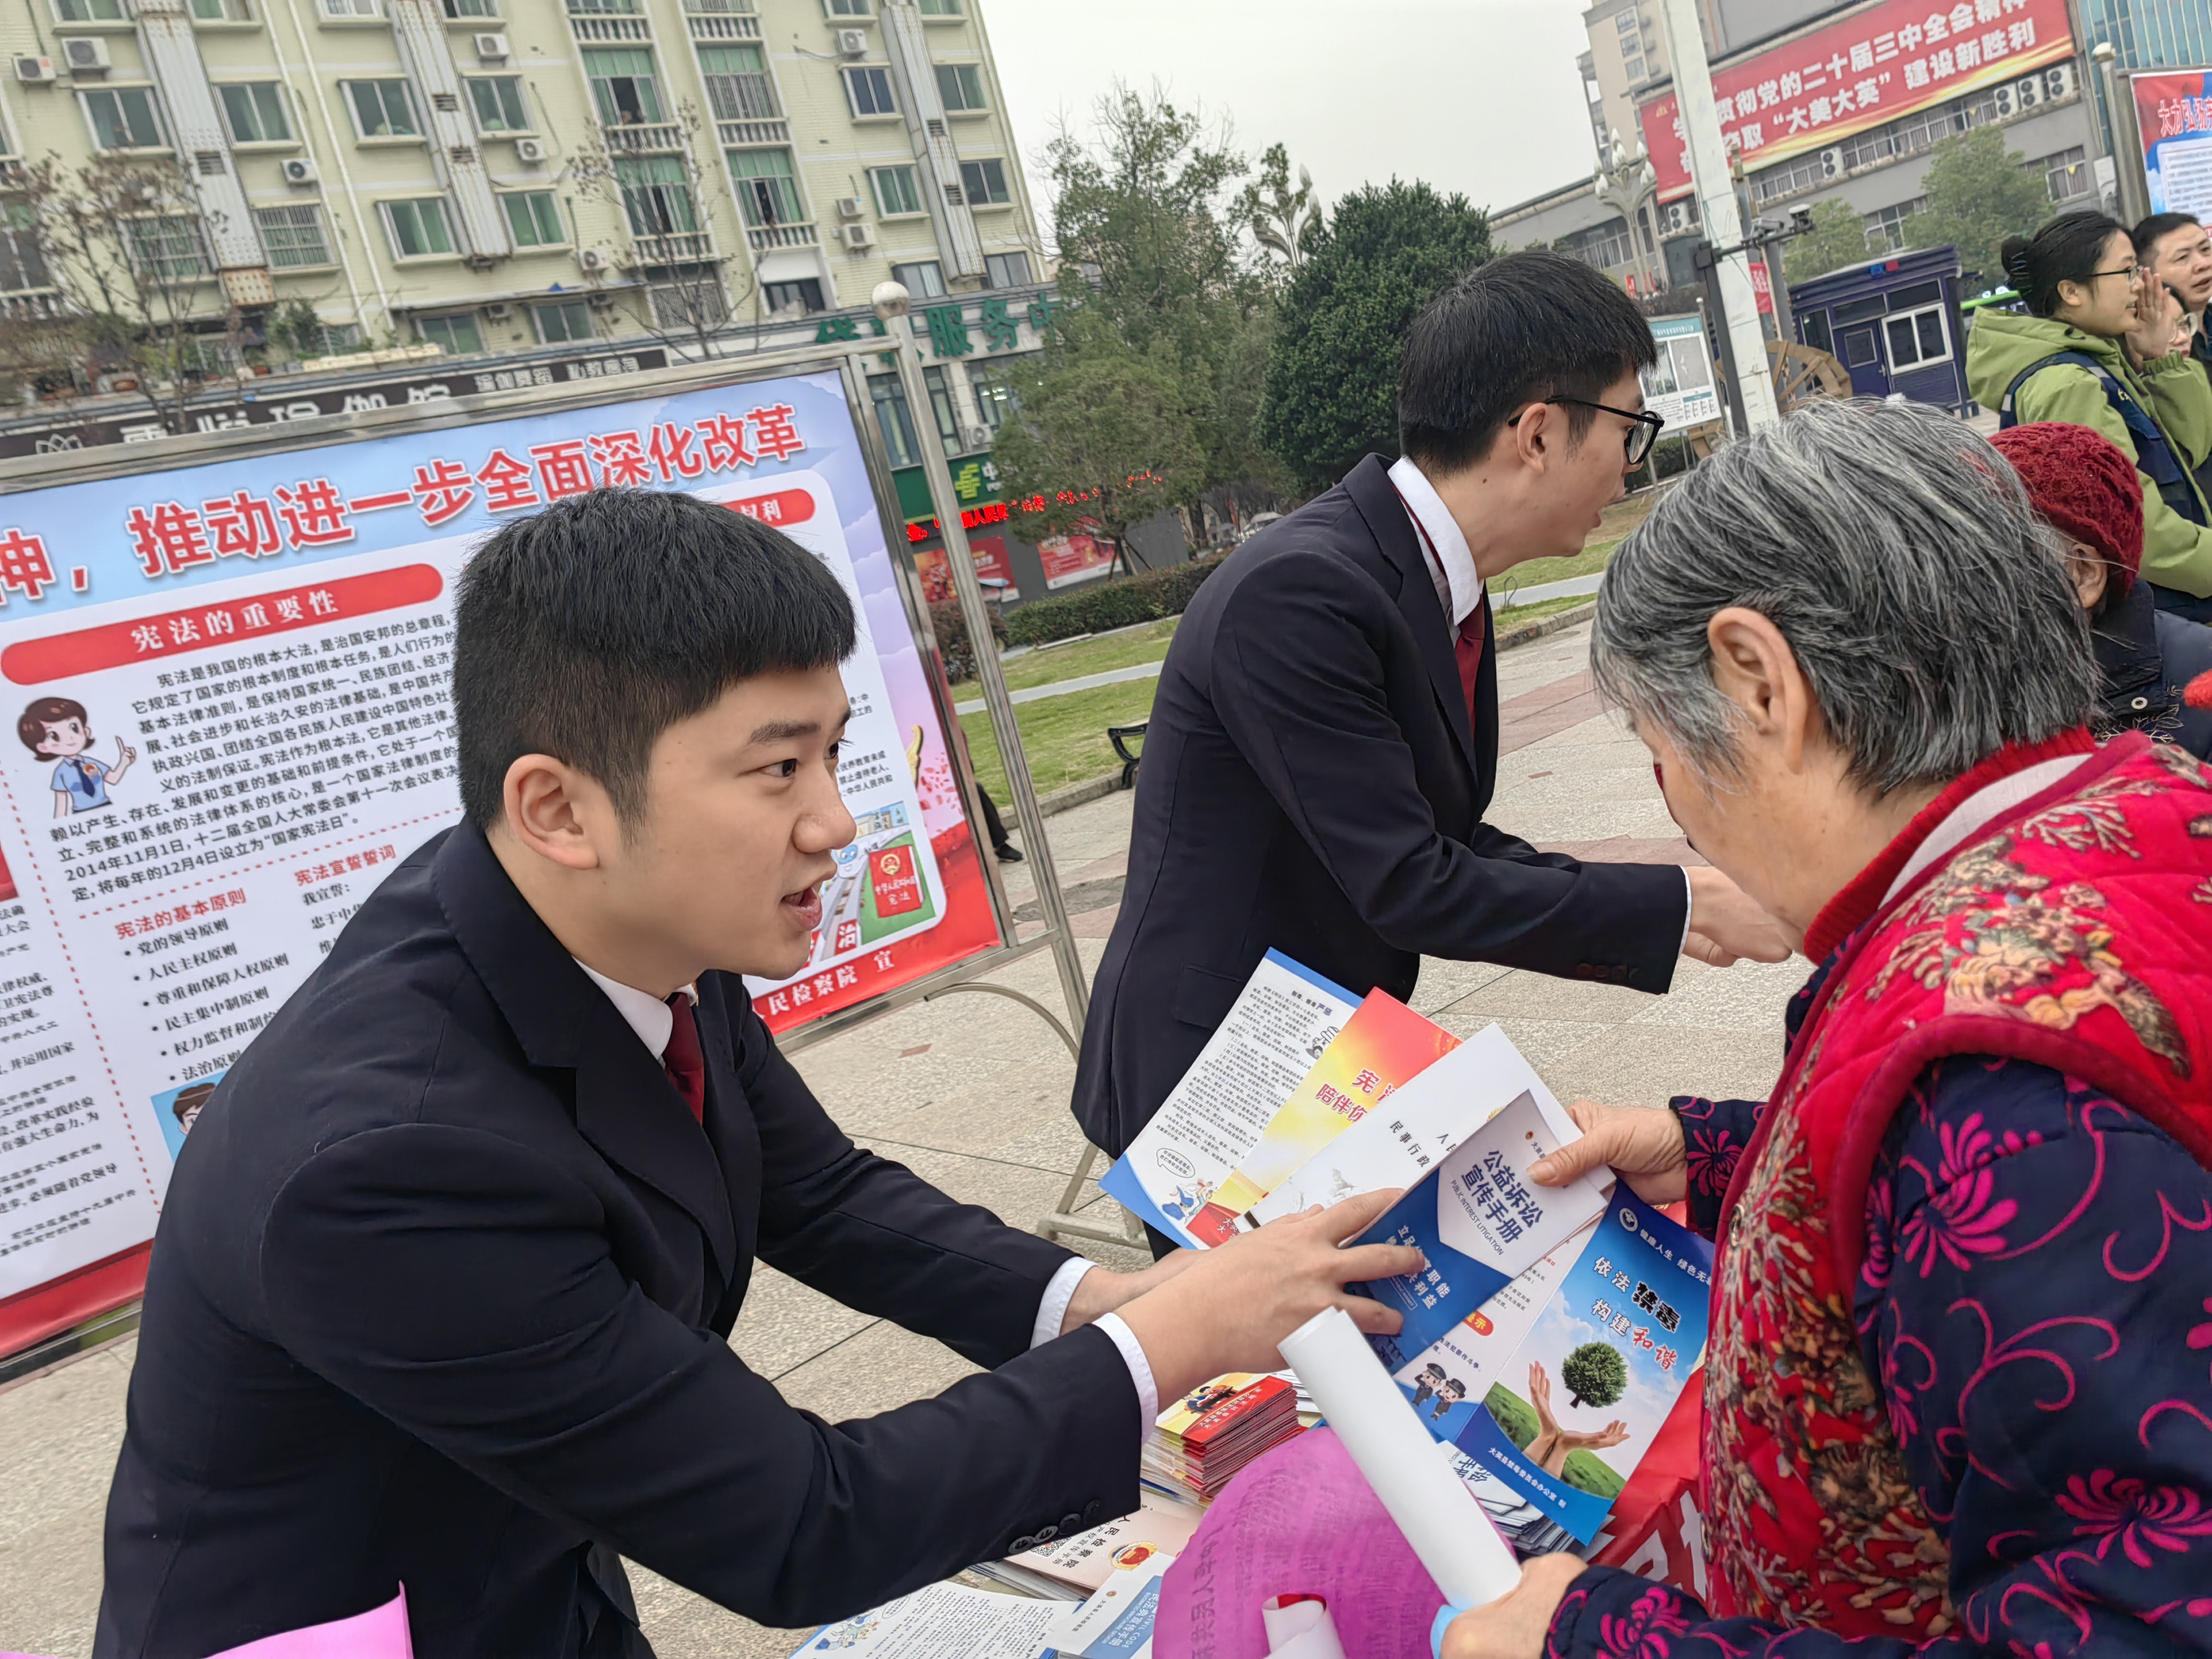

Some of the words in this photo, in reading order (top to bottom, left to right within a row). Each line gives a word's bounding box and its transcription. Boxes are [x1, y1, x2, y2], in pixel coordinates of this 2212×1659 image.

[130, 589, 340, 652] 宪法的重要性
[294, 844, 397, 887] 宪法宣誓誓词
[114, 888, 247, 940] 宪法的基本原则
[874, 949, 894, 972] 宣
[1390, 1120, 1431, 1168] 民事行政
[1451, 1179, 1464, 1199] PUBLIC
[1460, 1197, 1480, 1224] INTEREST
[1476, 1220, 1504, 1256] LITIGATION
[1461, 1164, 1523, 1244] 宣传手册
[1483, 1150, 1543, 1228] 公益诉讼
[1594, 1256, 1681, 1333] 依法禁毒
[1592, 1298, 1678, 1371] 构建和谐
[1121, 1632, 1141, 1649] CODE
